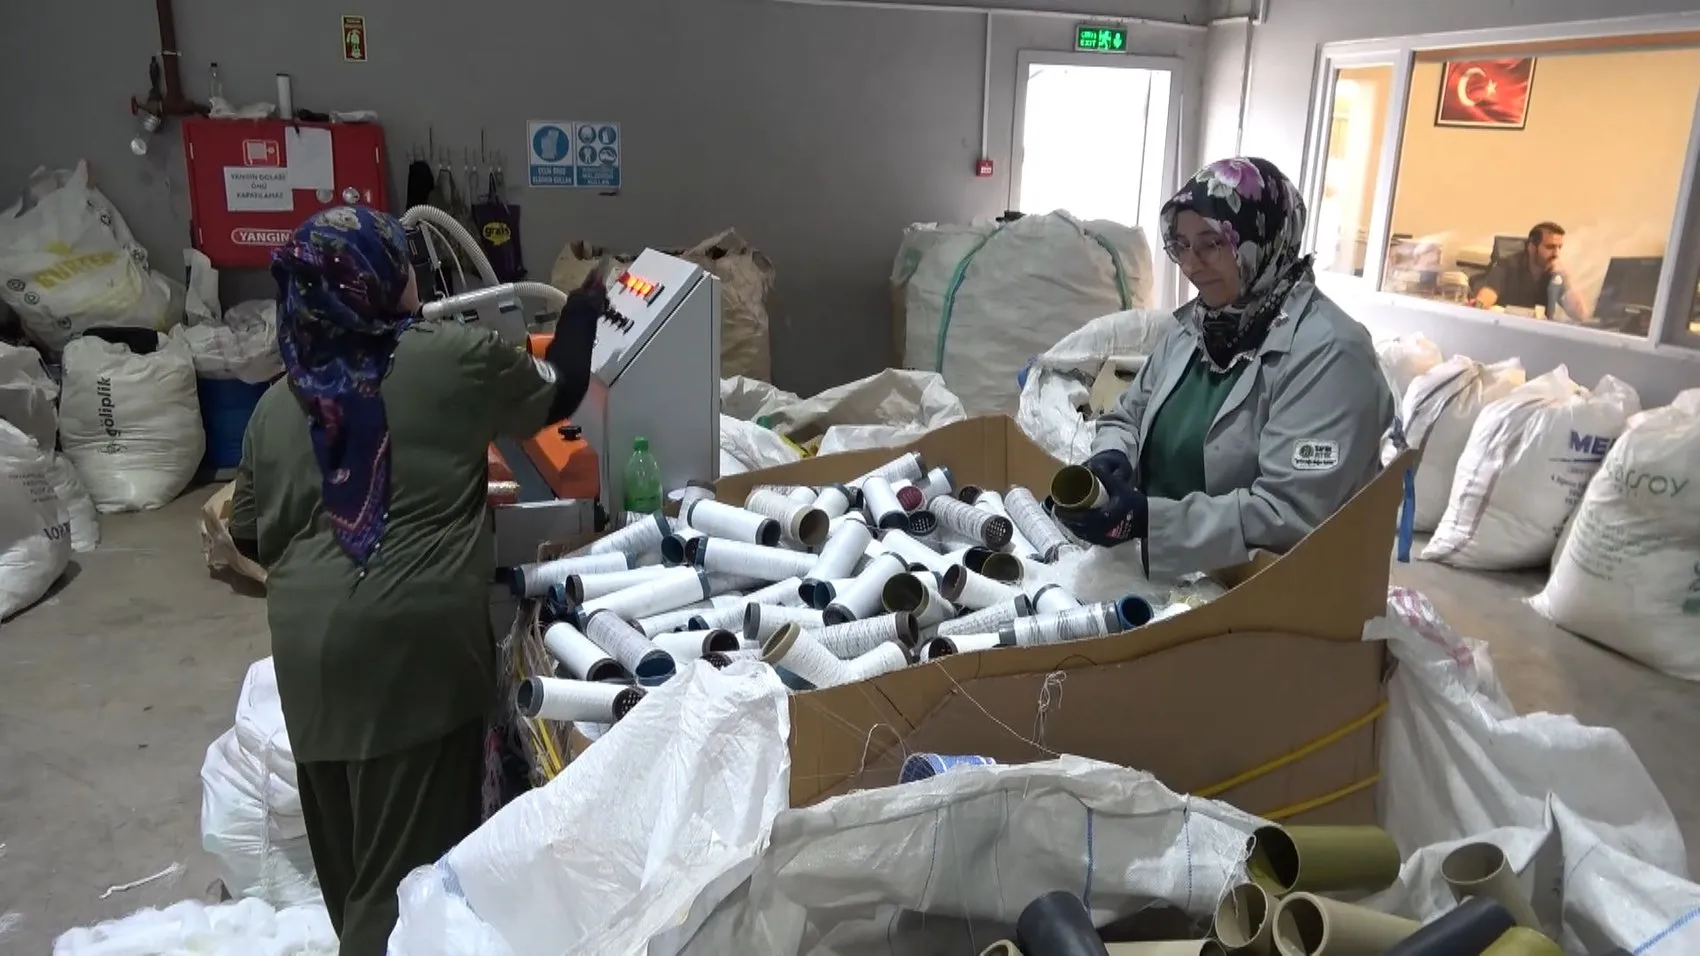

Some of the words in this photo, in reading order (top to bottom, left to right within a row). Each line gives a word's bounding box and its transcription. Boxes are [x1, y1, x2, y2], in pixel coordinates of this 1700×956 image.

[1080, 39, 1097, 47] EXIT
[239, 231, 291, 243] YANGIN
[97, 376, 121, 438] göliplik
